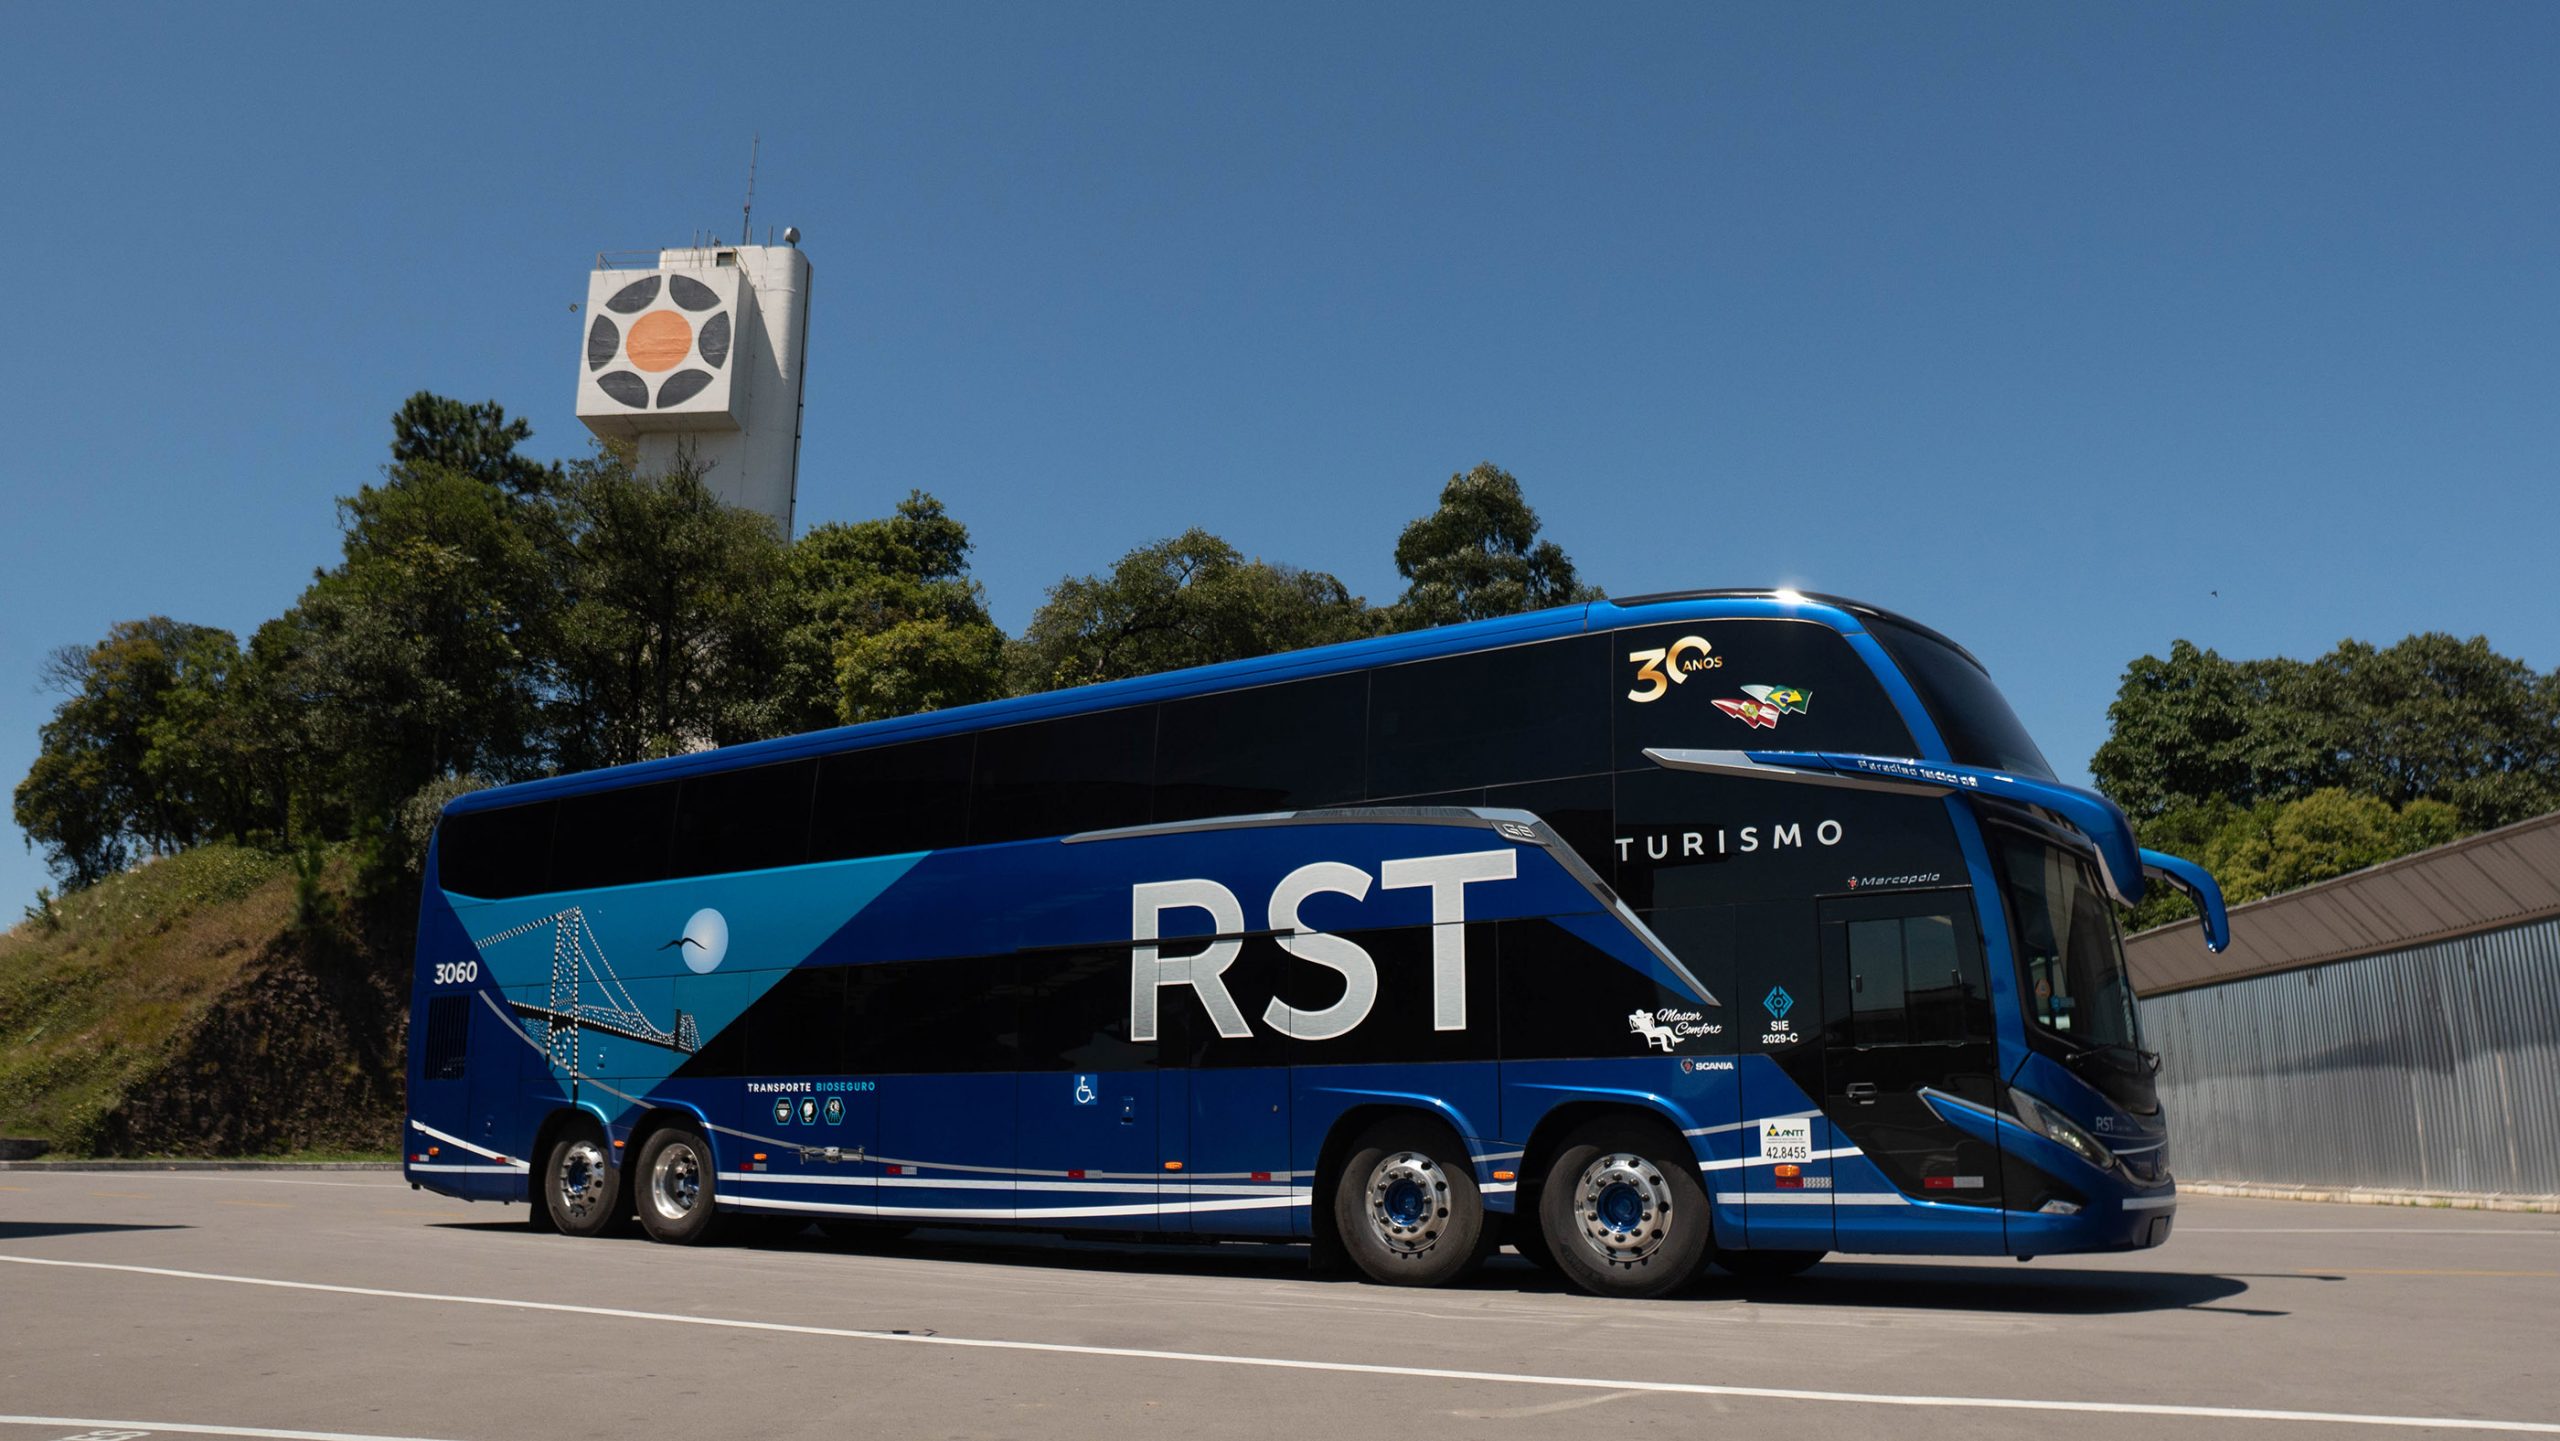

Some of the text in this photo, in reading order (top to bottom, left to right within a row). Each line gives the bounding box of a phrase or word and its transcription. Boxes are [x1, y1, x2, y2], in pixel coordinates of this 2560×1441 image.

[1682, 656, 1723, 672] ANOS
[1614, 819, 1843, 862] TURISMO
[1861, 872, 1941, 887] Marcopolo
[1131, 848, 1517, 1042] RST
[434, 960, 478, 985] 3060
[1656, 1008, 1702, 1022] Master
[1675, 1021, 1722, 1038] Comfort
[1770, 1020, 1790, 1032] SIE
[1762, 1032, 1799, 1044] 2029-C
[1695, 1061, 1734, 1071] SCANIA
[747, 1081, 876, 1093] TRANSPORTE BIOSEGURO
[2096, 1115, 2114, 1131] RST
[1781, 1129, 1804, 1137] ANTT
[1766, 1146, 1807, 1160] 42.8455
